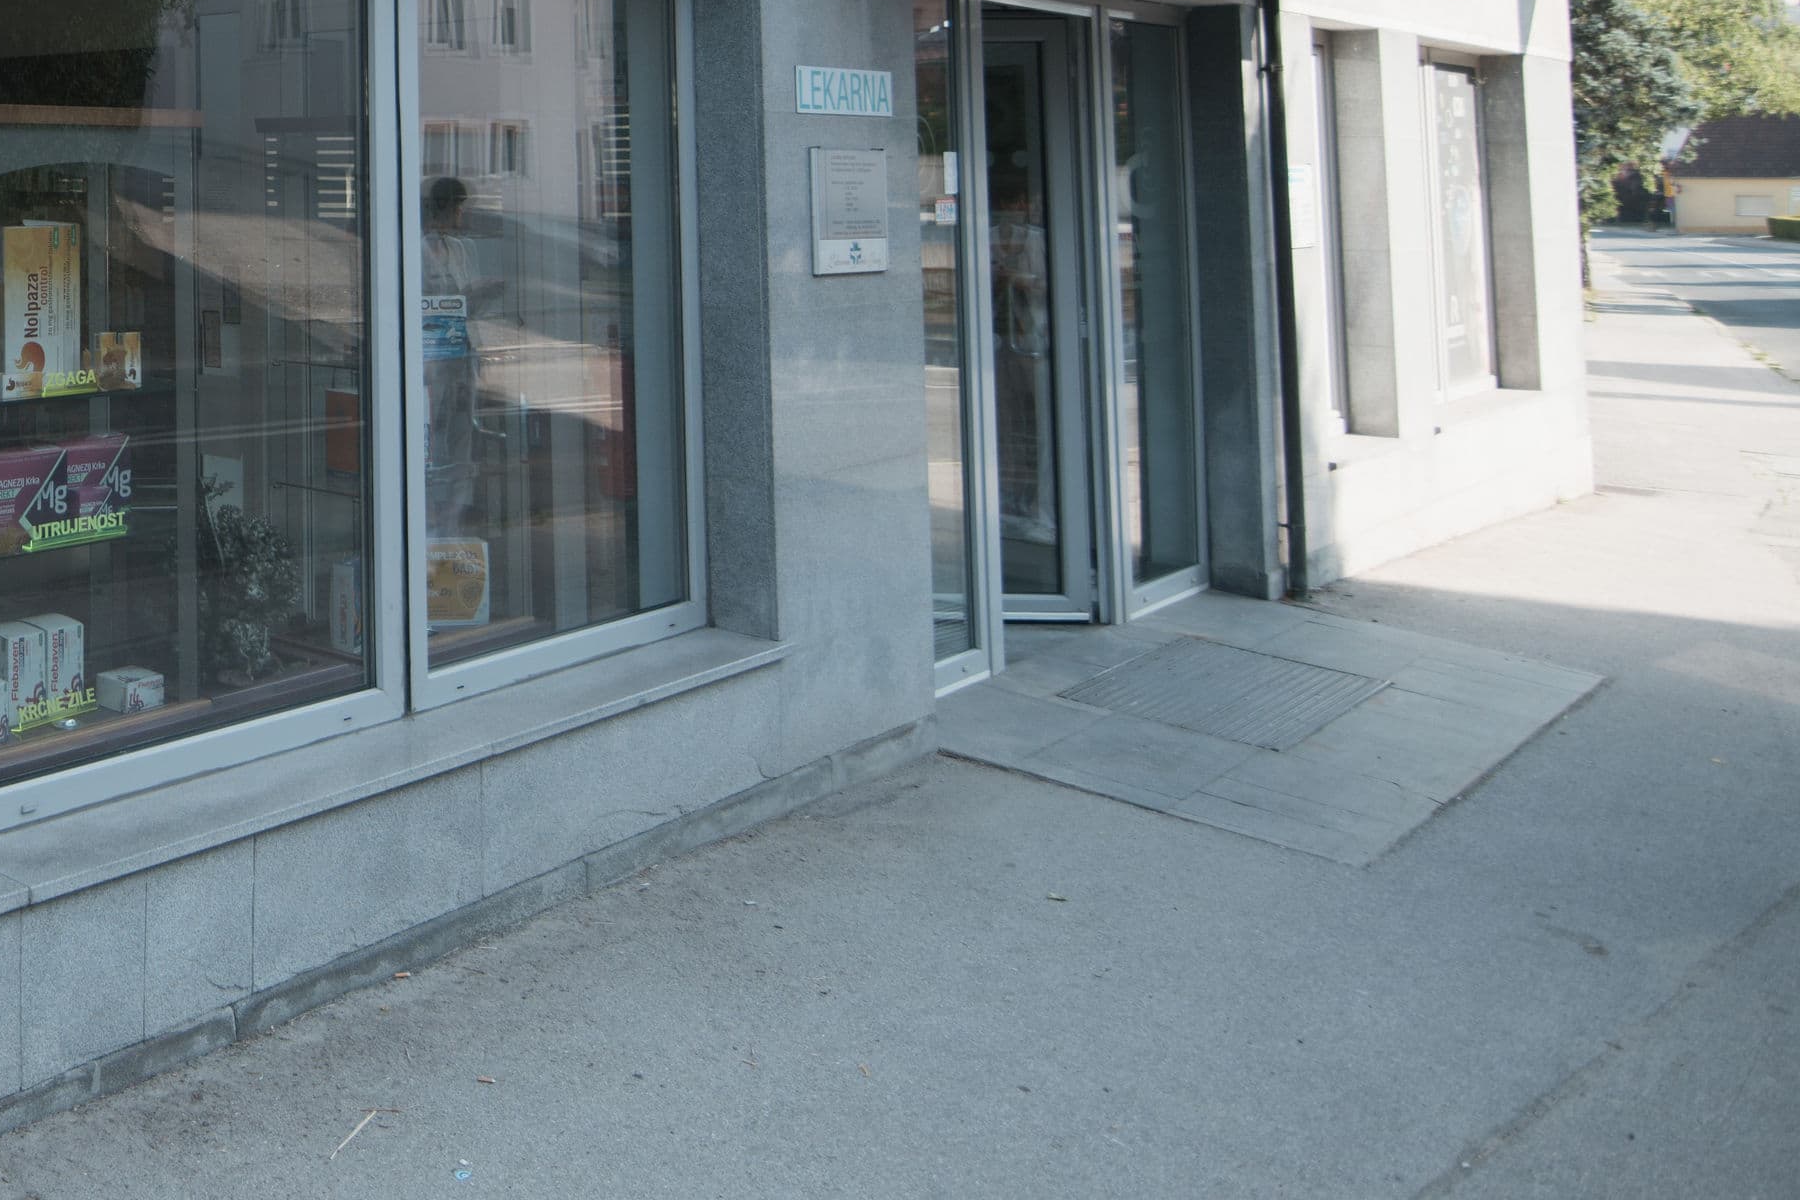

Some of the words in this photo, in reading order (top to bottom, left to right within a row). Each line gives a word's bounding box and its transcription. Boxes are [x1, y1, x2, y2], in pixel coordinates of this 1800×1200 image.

[798, 68, 890, 114] LEKARNA
[40, 266, 49, 306] control
[24, 272, 41, 339] Nolpaza
[67, 464, 92, 474] AGNEZIJ
[102, 465, 132, 498] Mg
[36, 480, 68, 514] Mg
[32, 511, 126, 541] UTRUJENOST
[11, 641, 19, 702] Flebaven
[51, 632, 59, 692] Flebaven
[18, 695, 66, 723] KRČNE
[67, 687, 97, 709] ŽILE
